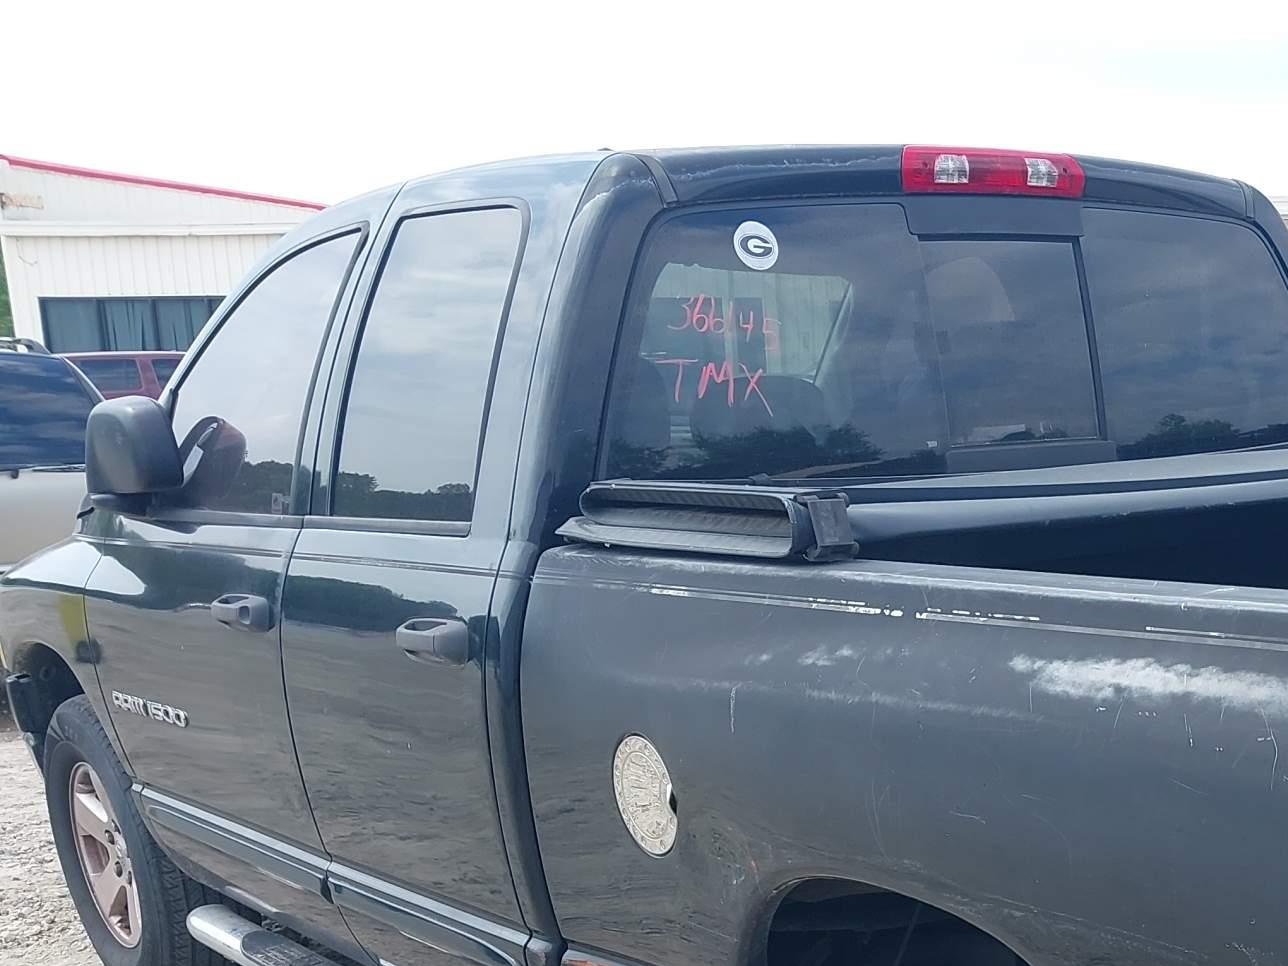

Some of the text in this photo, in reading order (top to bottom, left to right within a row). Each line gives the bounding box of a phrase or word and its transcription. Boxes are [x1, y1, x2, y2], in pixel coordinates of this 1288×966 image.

[666, 293, 783, 352] 366145
[654, 358, 773, 417] TMX
[112, 690, 189, 729] RAM 1500
